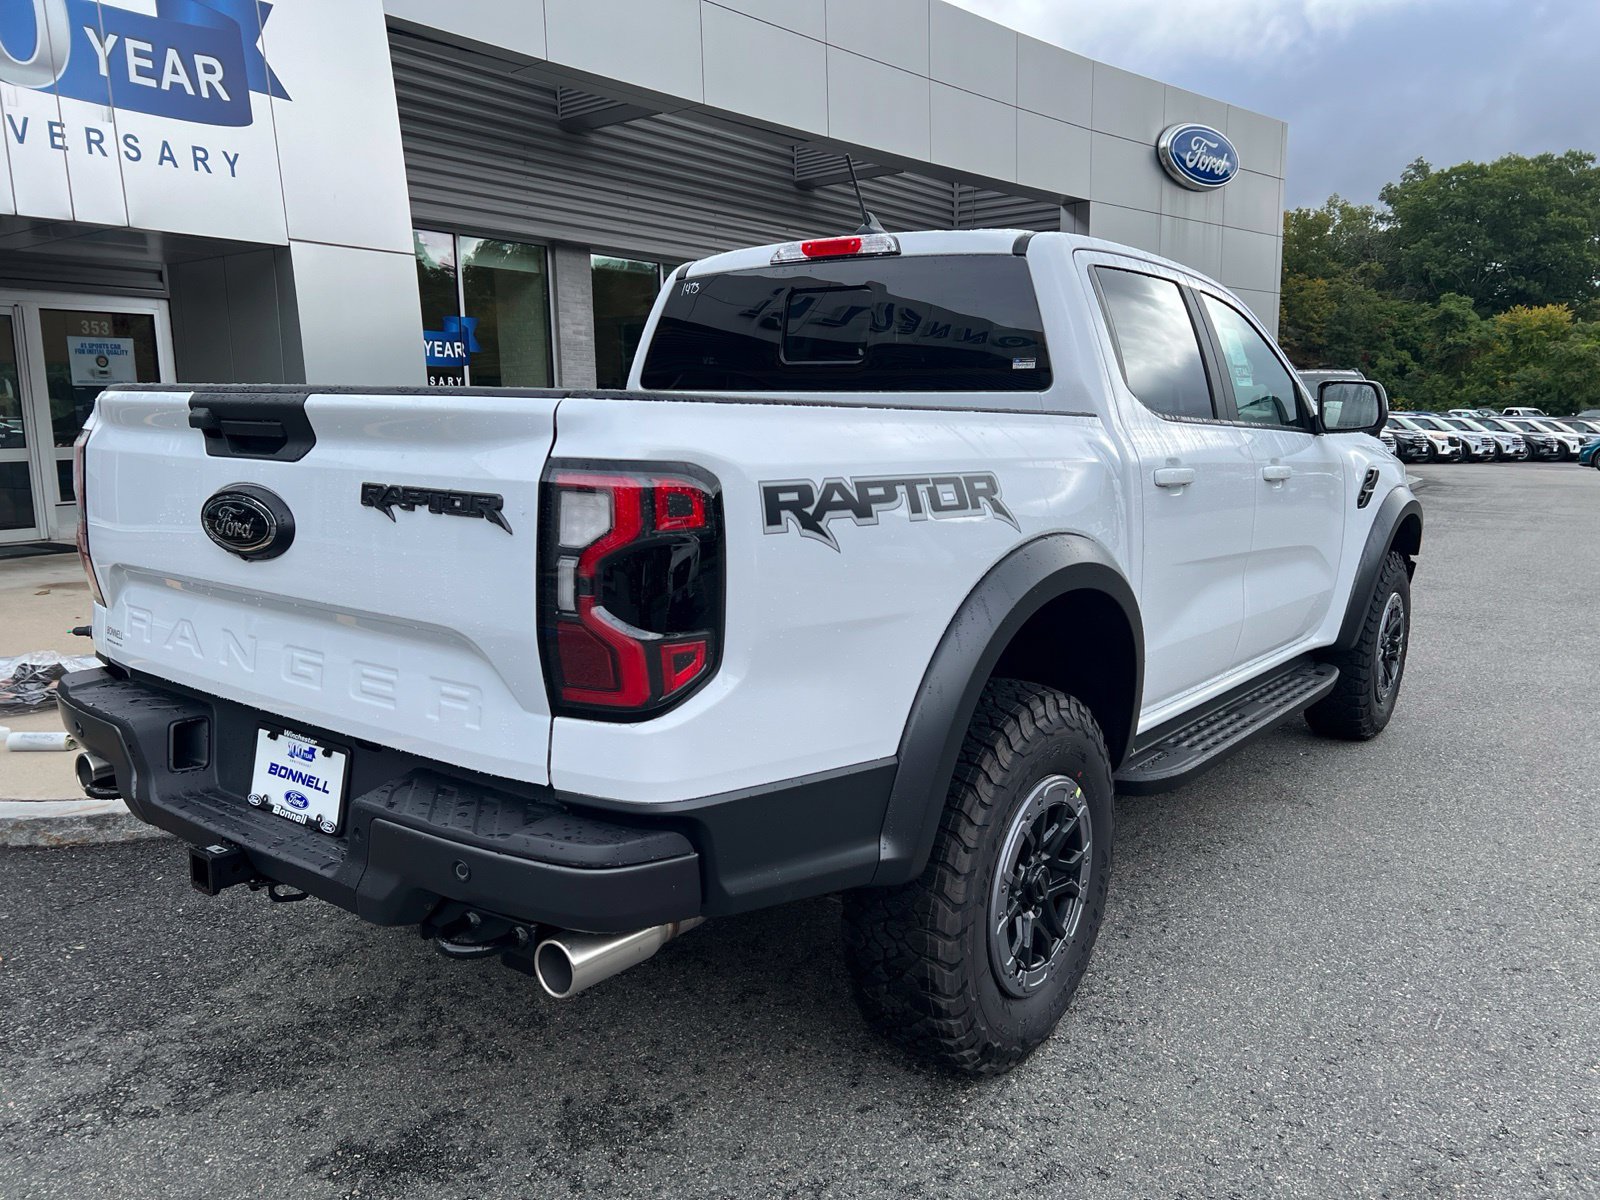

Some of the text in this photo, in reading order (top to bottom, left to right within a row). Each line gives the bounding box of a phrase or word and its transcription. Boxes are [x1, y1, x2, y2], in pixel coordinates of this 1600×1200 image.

[83, 25, 231, 101] YEAR
[6, 113, 240, 178] VERSARY
[81, 320, 109, 335] 353
[105, 349, 129, 357] QUALITY
[423, 340, 466, 358] YEAR
[429, 376, 462, 386] SARY
[361, 482, 513, 536] RAPTOR
[759, 470, 1021, 552] RAPTOR
[124, 604, 483, 731] RANGER
[283, 729, 318, 745] Winchester
[268, 762, 329, 794] BONNELL
[272, 804, 308, 825] Bonnell
